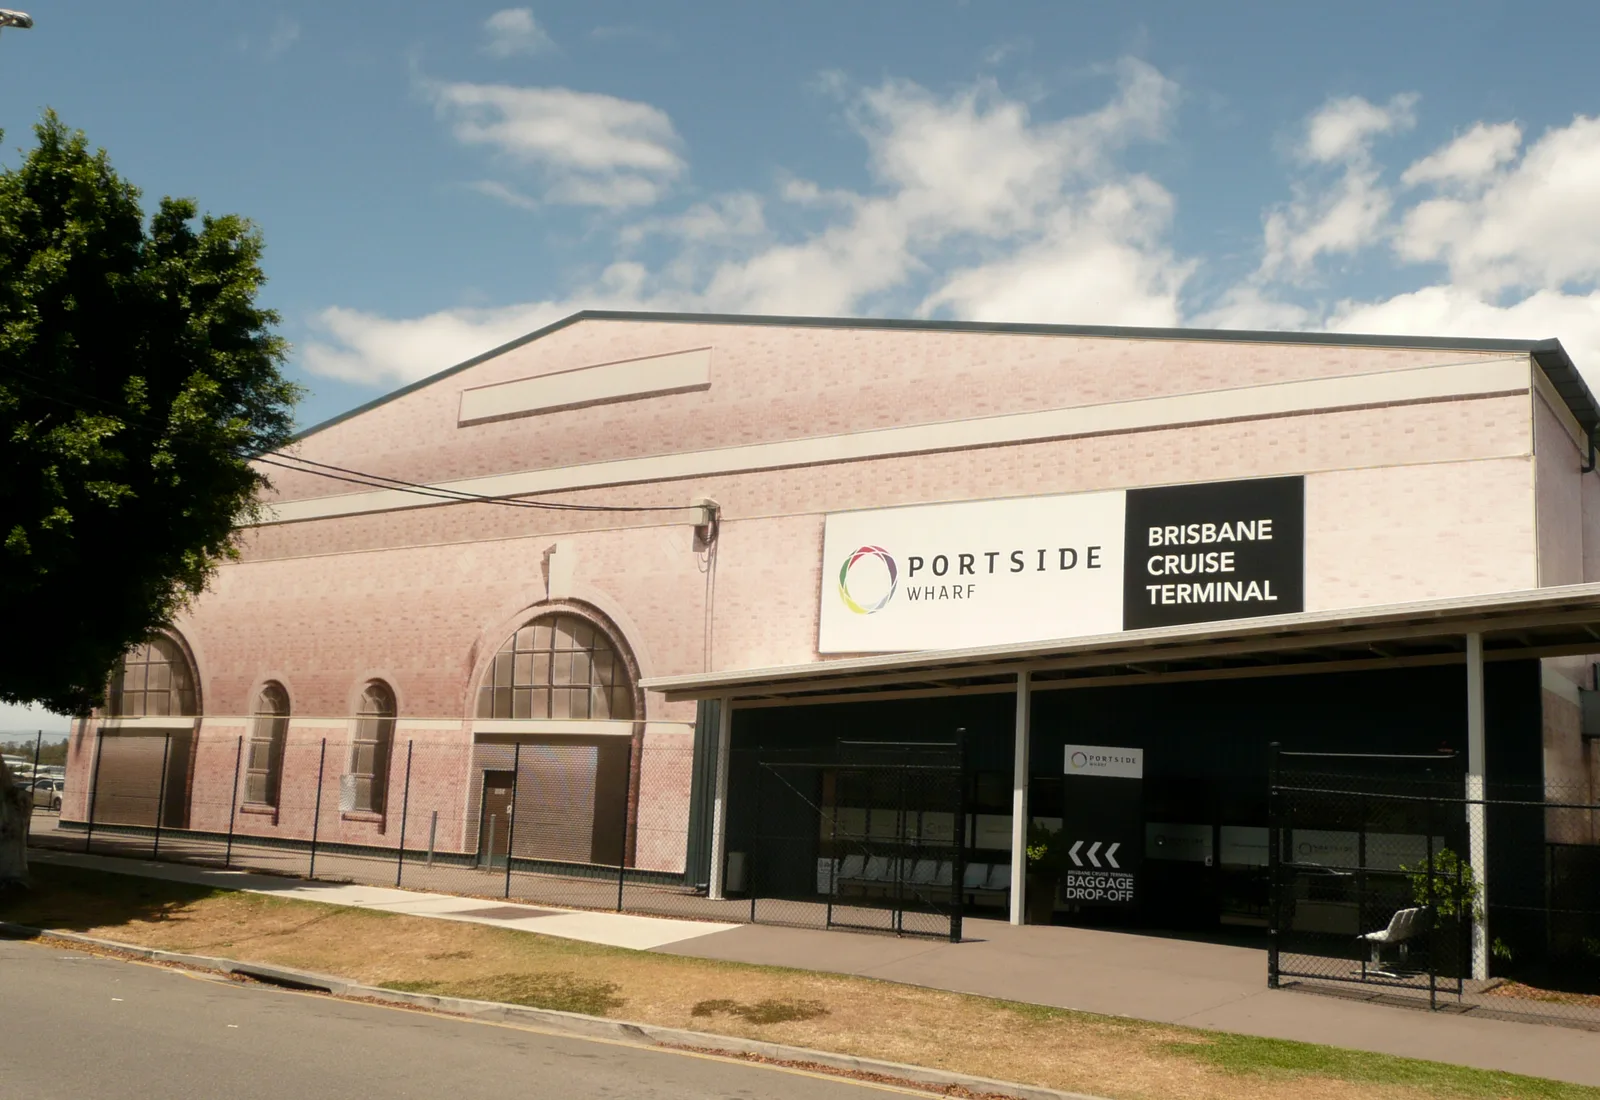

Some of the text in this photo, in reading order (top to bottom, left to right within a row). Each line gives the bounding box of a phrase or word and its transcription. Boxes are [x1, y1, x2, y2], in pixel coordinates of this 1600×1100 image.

[1148, 519, 1273, 547] BRISBANE
[908, 545, 1102, 578] PORTSIDE
[1147, 551, 1236, 576] CRUISE
[906, 584, 976, 601] WHARF
[1146, 580, 1278, 605] TERMINAL
[1089, 755, 1137, 765] PORTSIDE
[1067, 875, 1134, 890] BAGGAGE
[1066, 887, 1134, 902] DROP-OFF
